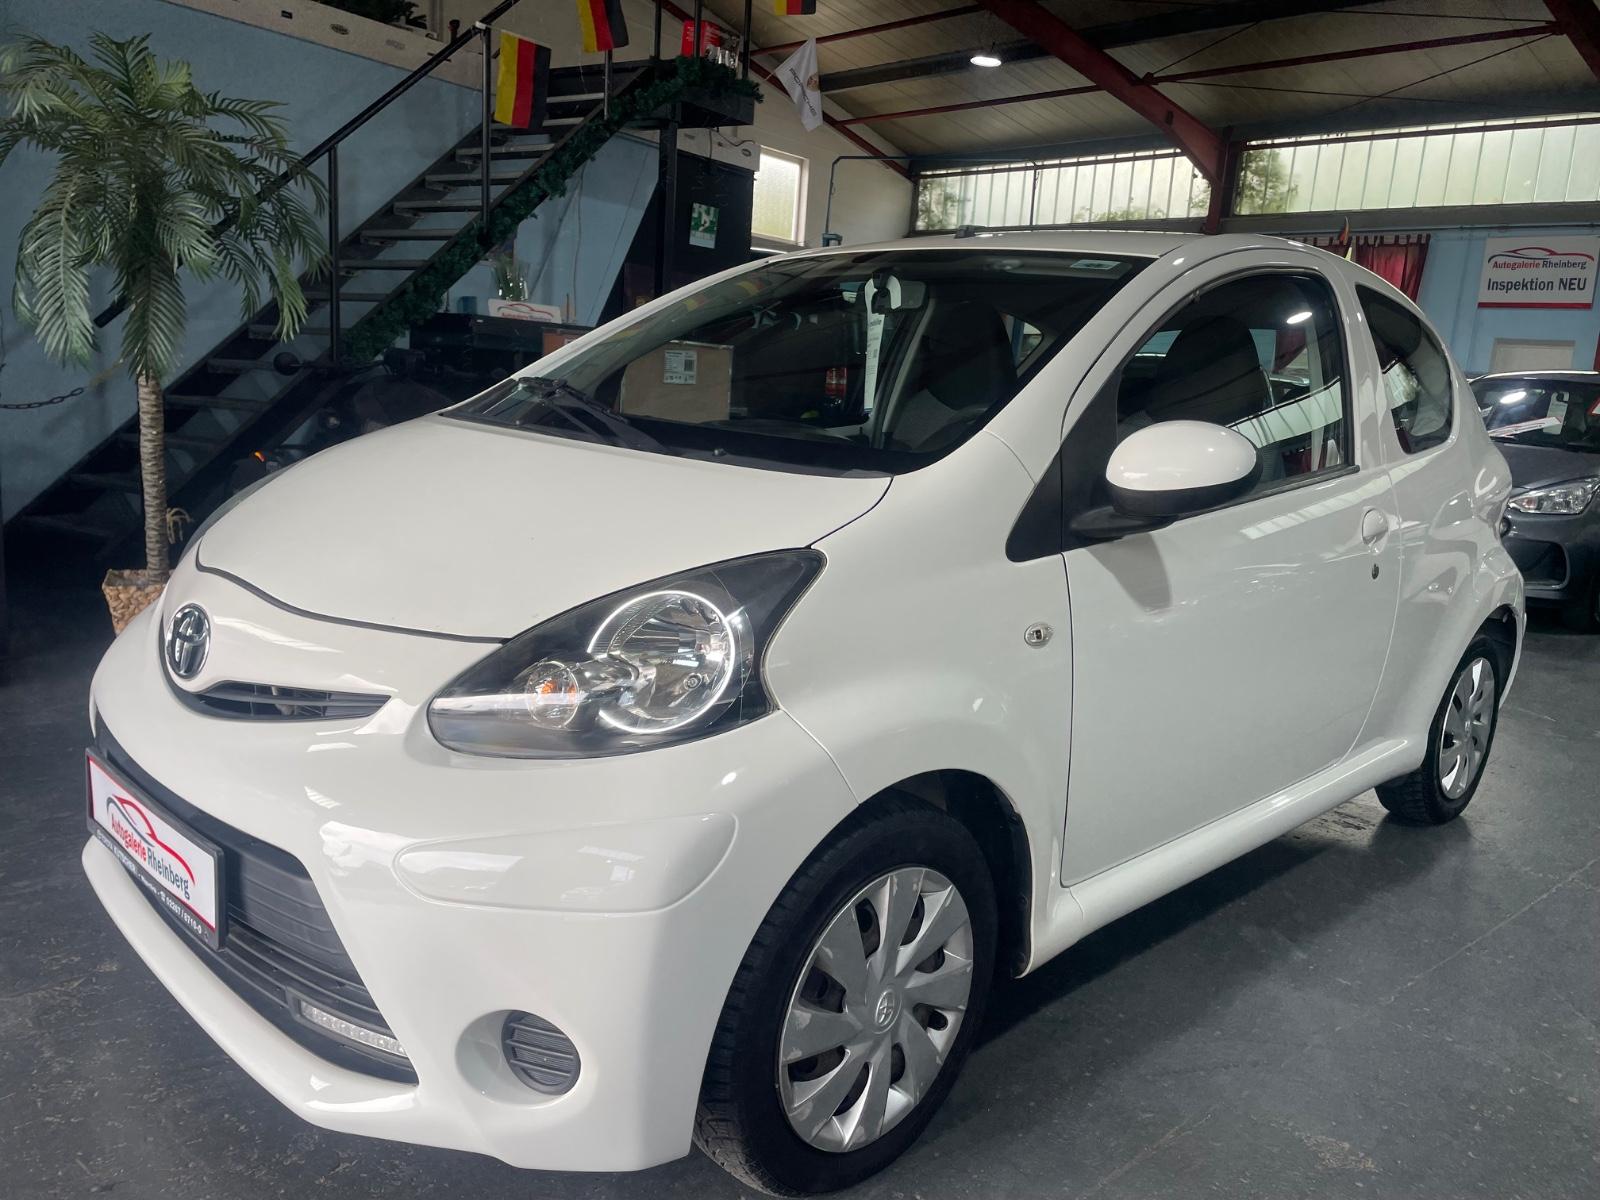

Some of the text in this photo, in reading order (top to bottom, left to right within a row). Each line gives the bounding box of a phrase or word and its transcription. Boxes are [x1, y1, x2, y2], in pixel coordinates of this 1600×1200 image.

[1492, 260, 1587, 271] Autogalerie Rheinberg
[1487, 277, 1588, 293] Inspektion NEU
[111, 813, 147, 862] Autogalerie
[147, 847, 190, 900] Rheinberg
